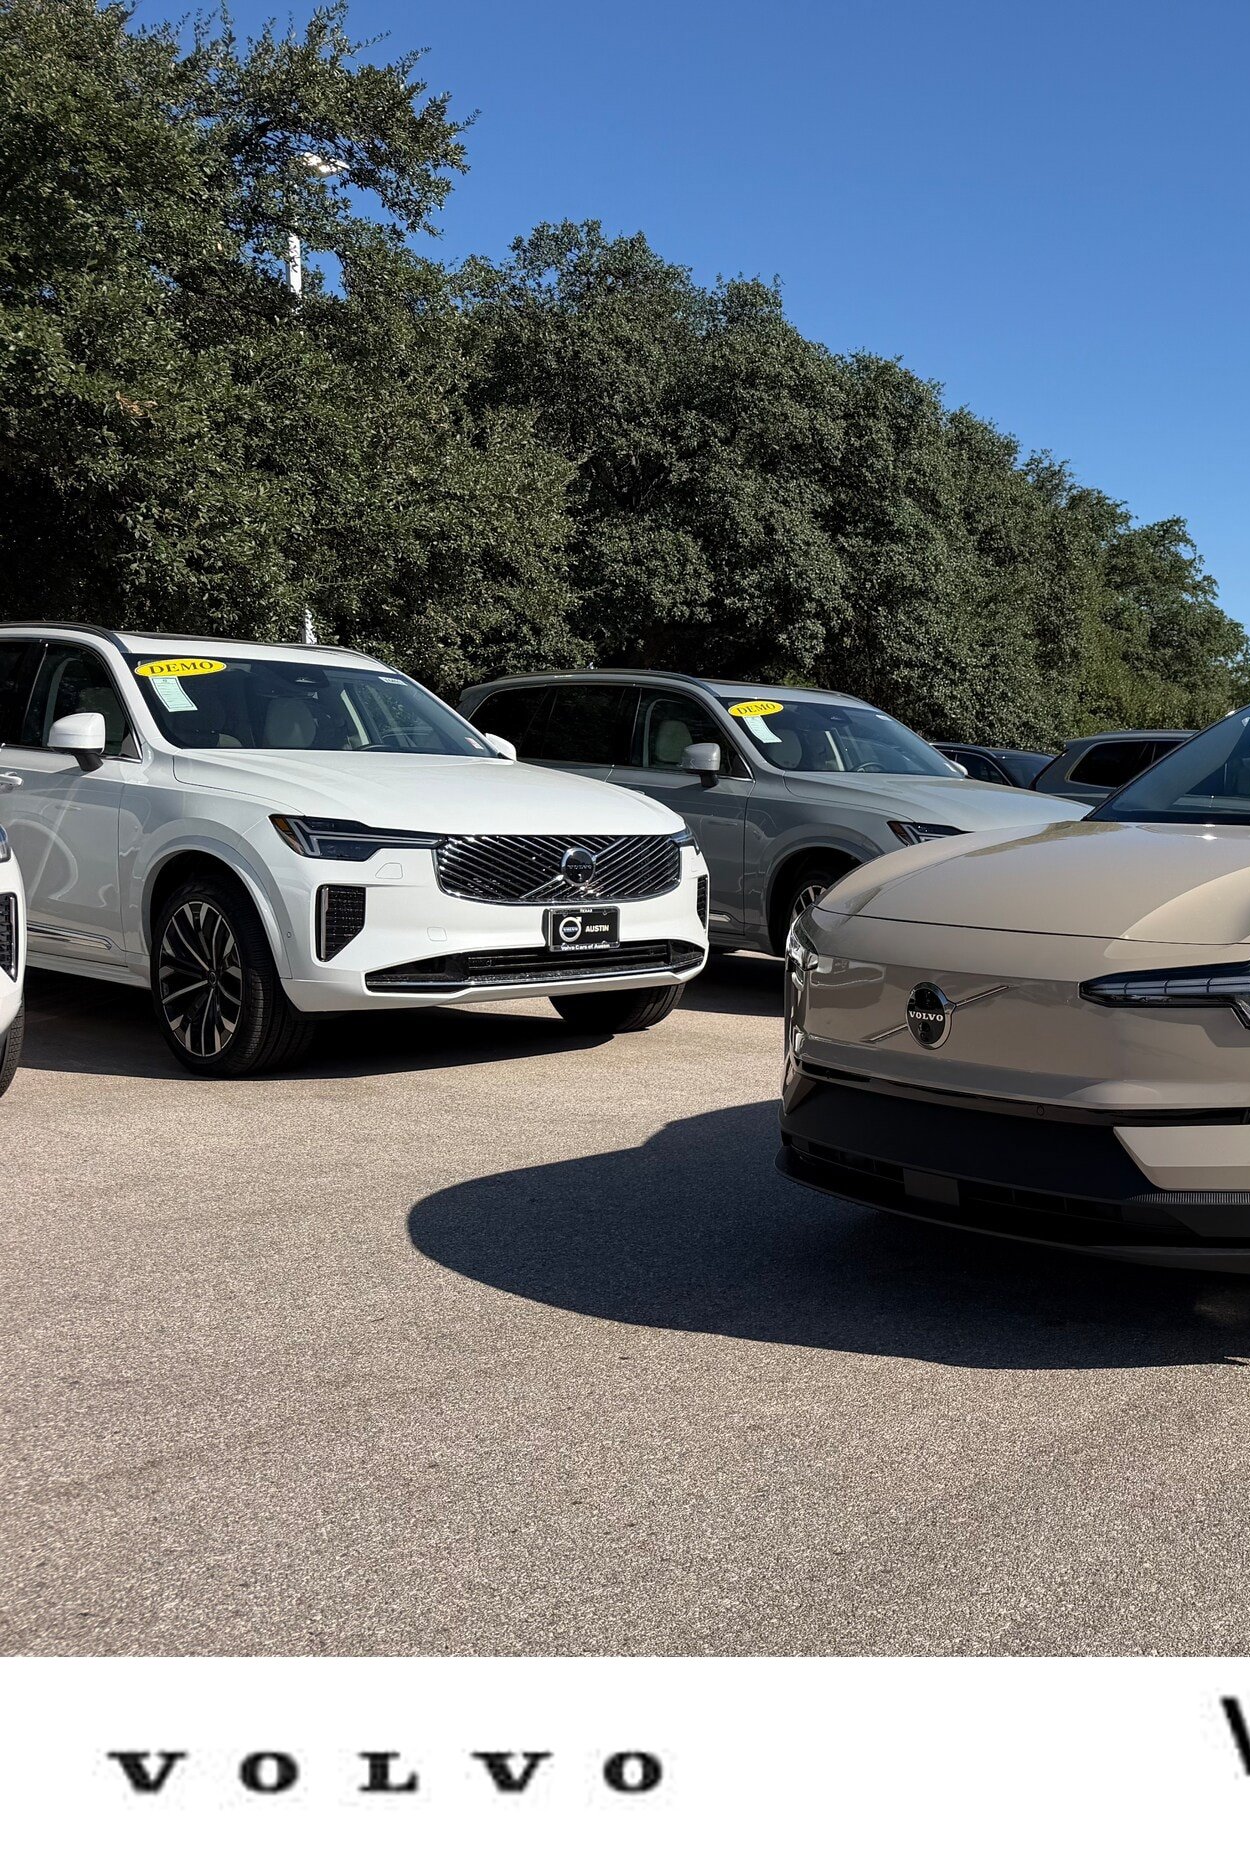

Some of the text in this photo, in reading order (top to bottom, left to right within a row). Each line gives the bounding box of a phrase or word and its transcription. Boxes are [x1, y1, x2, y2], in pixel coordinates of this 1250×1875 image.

[149, 660, 214, 675] DEMO
[736, 703, 776, 715] DEMO
[585, 924, 610, 933] AUSTIN
[908, 1010, 944, 1022] VOLVO
